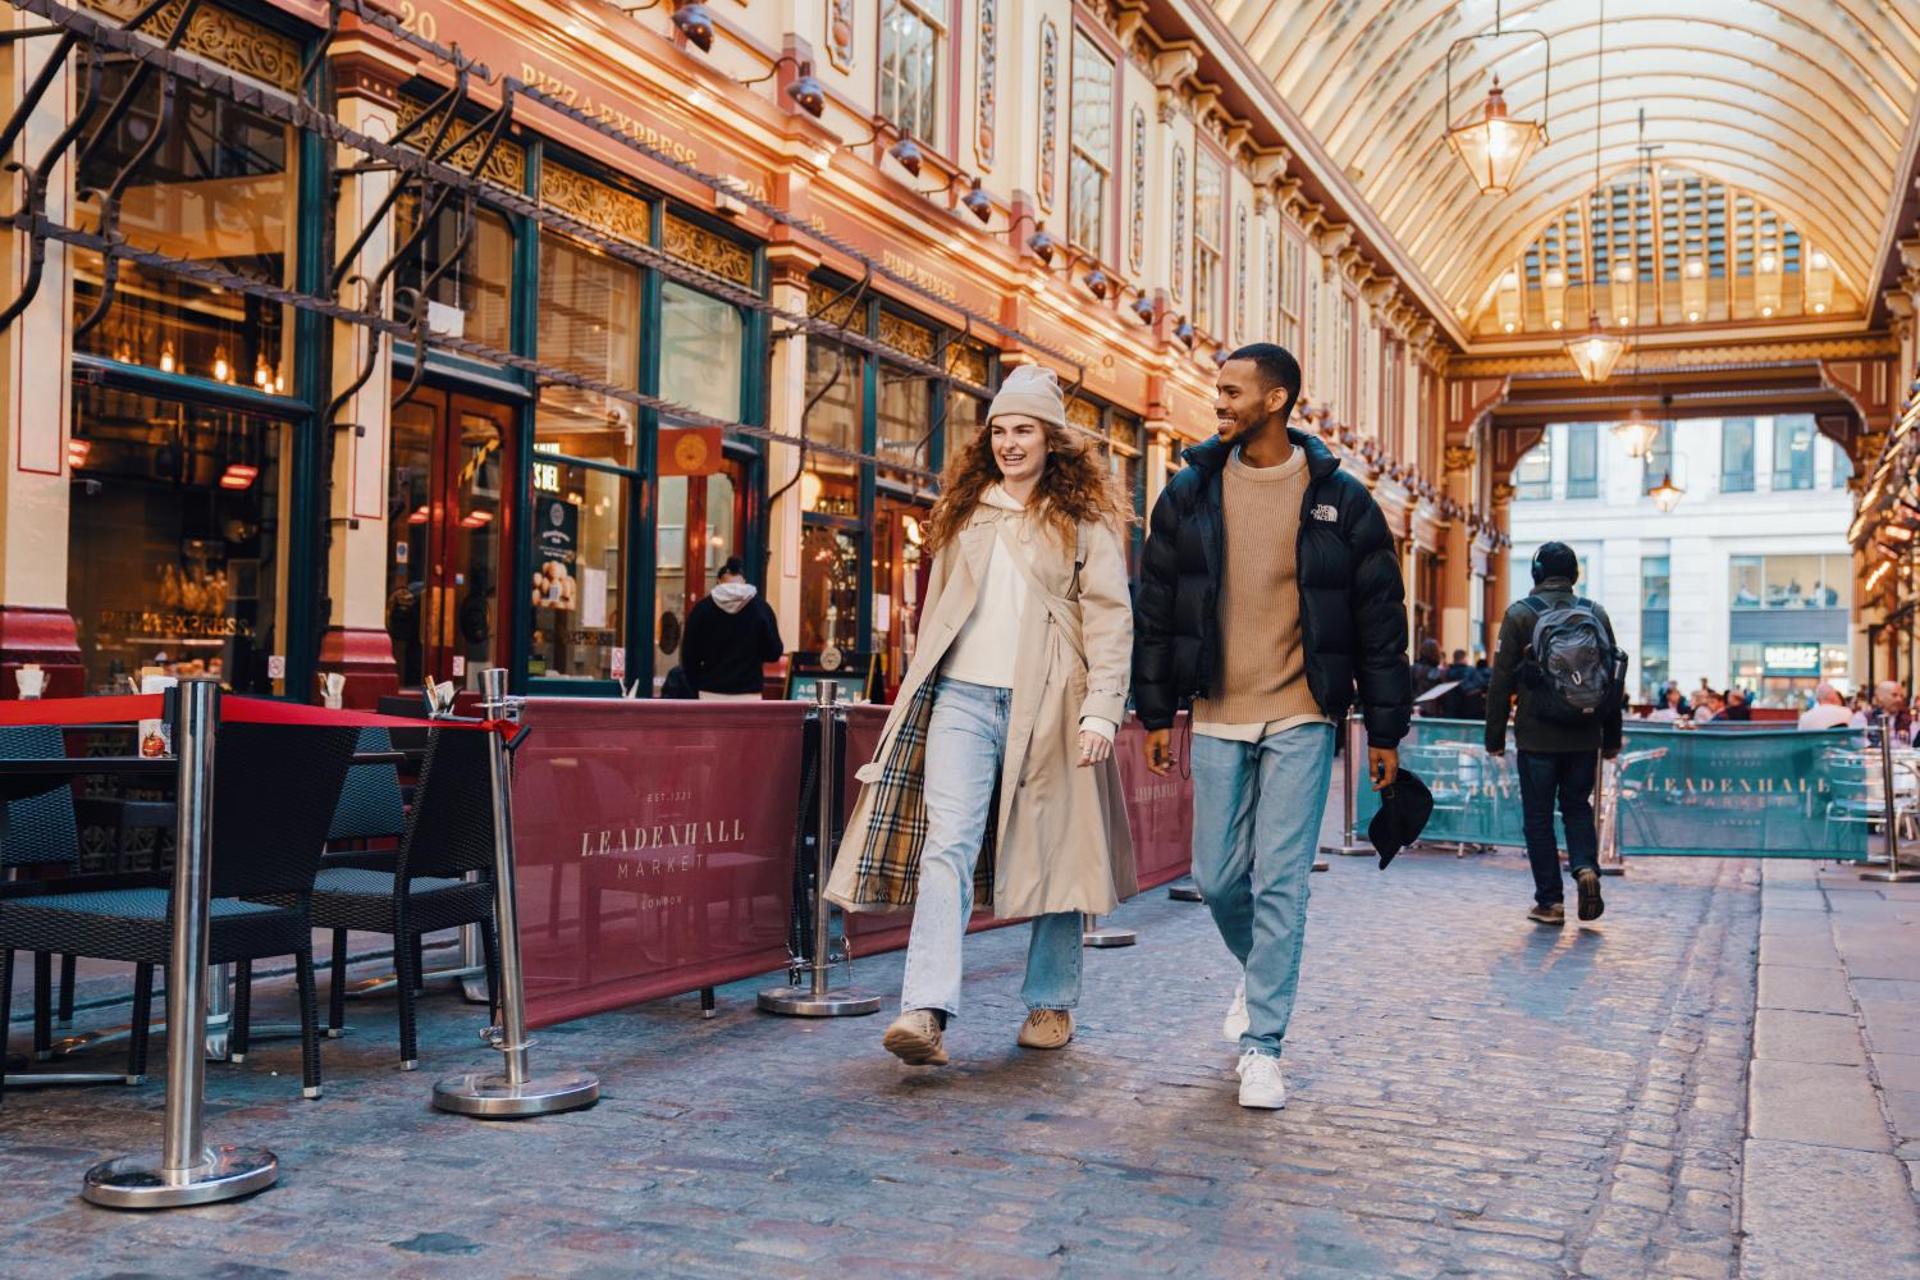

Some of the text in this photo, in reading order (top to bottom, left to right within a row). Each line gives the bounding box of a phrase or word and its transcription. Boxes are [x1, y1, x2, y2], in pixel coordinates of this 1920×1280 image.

[400, 3, 437, 43] 20
[1647, 777, 1830, 793] LEADENHALL
[580, 819, 745, 857] LEADENHALL
[617, 853, 703, 879] MARKET
[641, 896, 682, 910] LONDON
